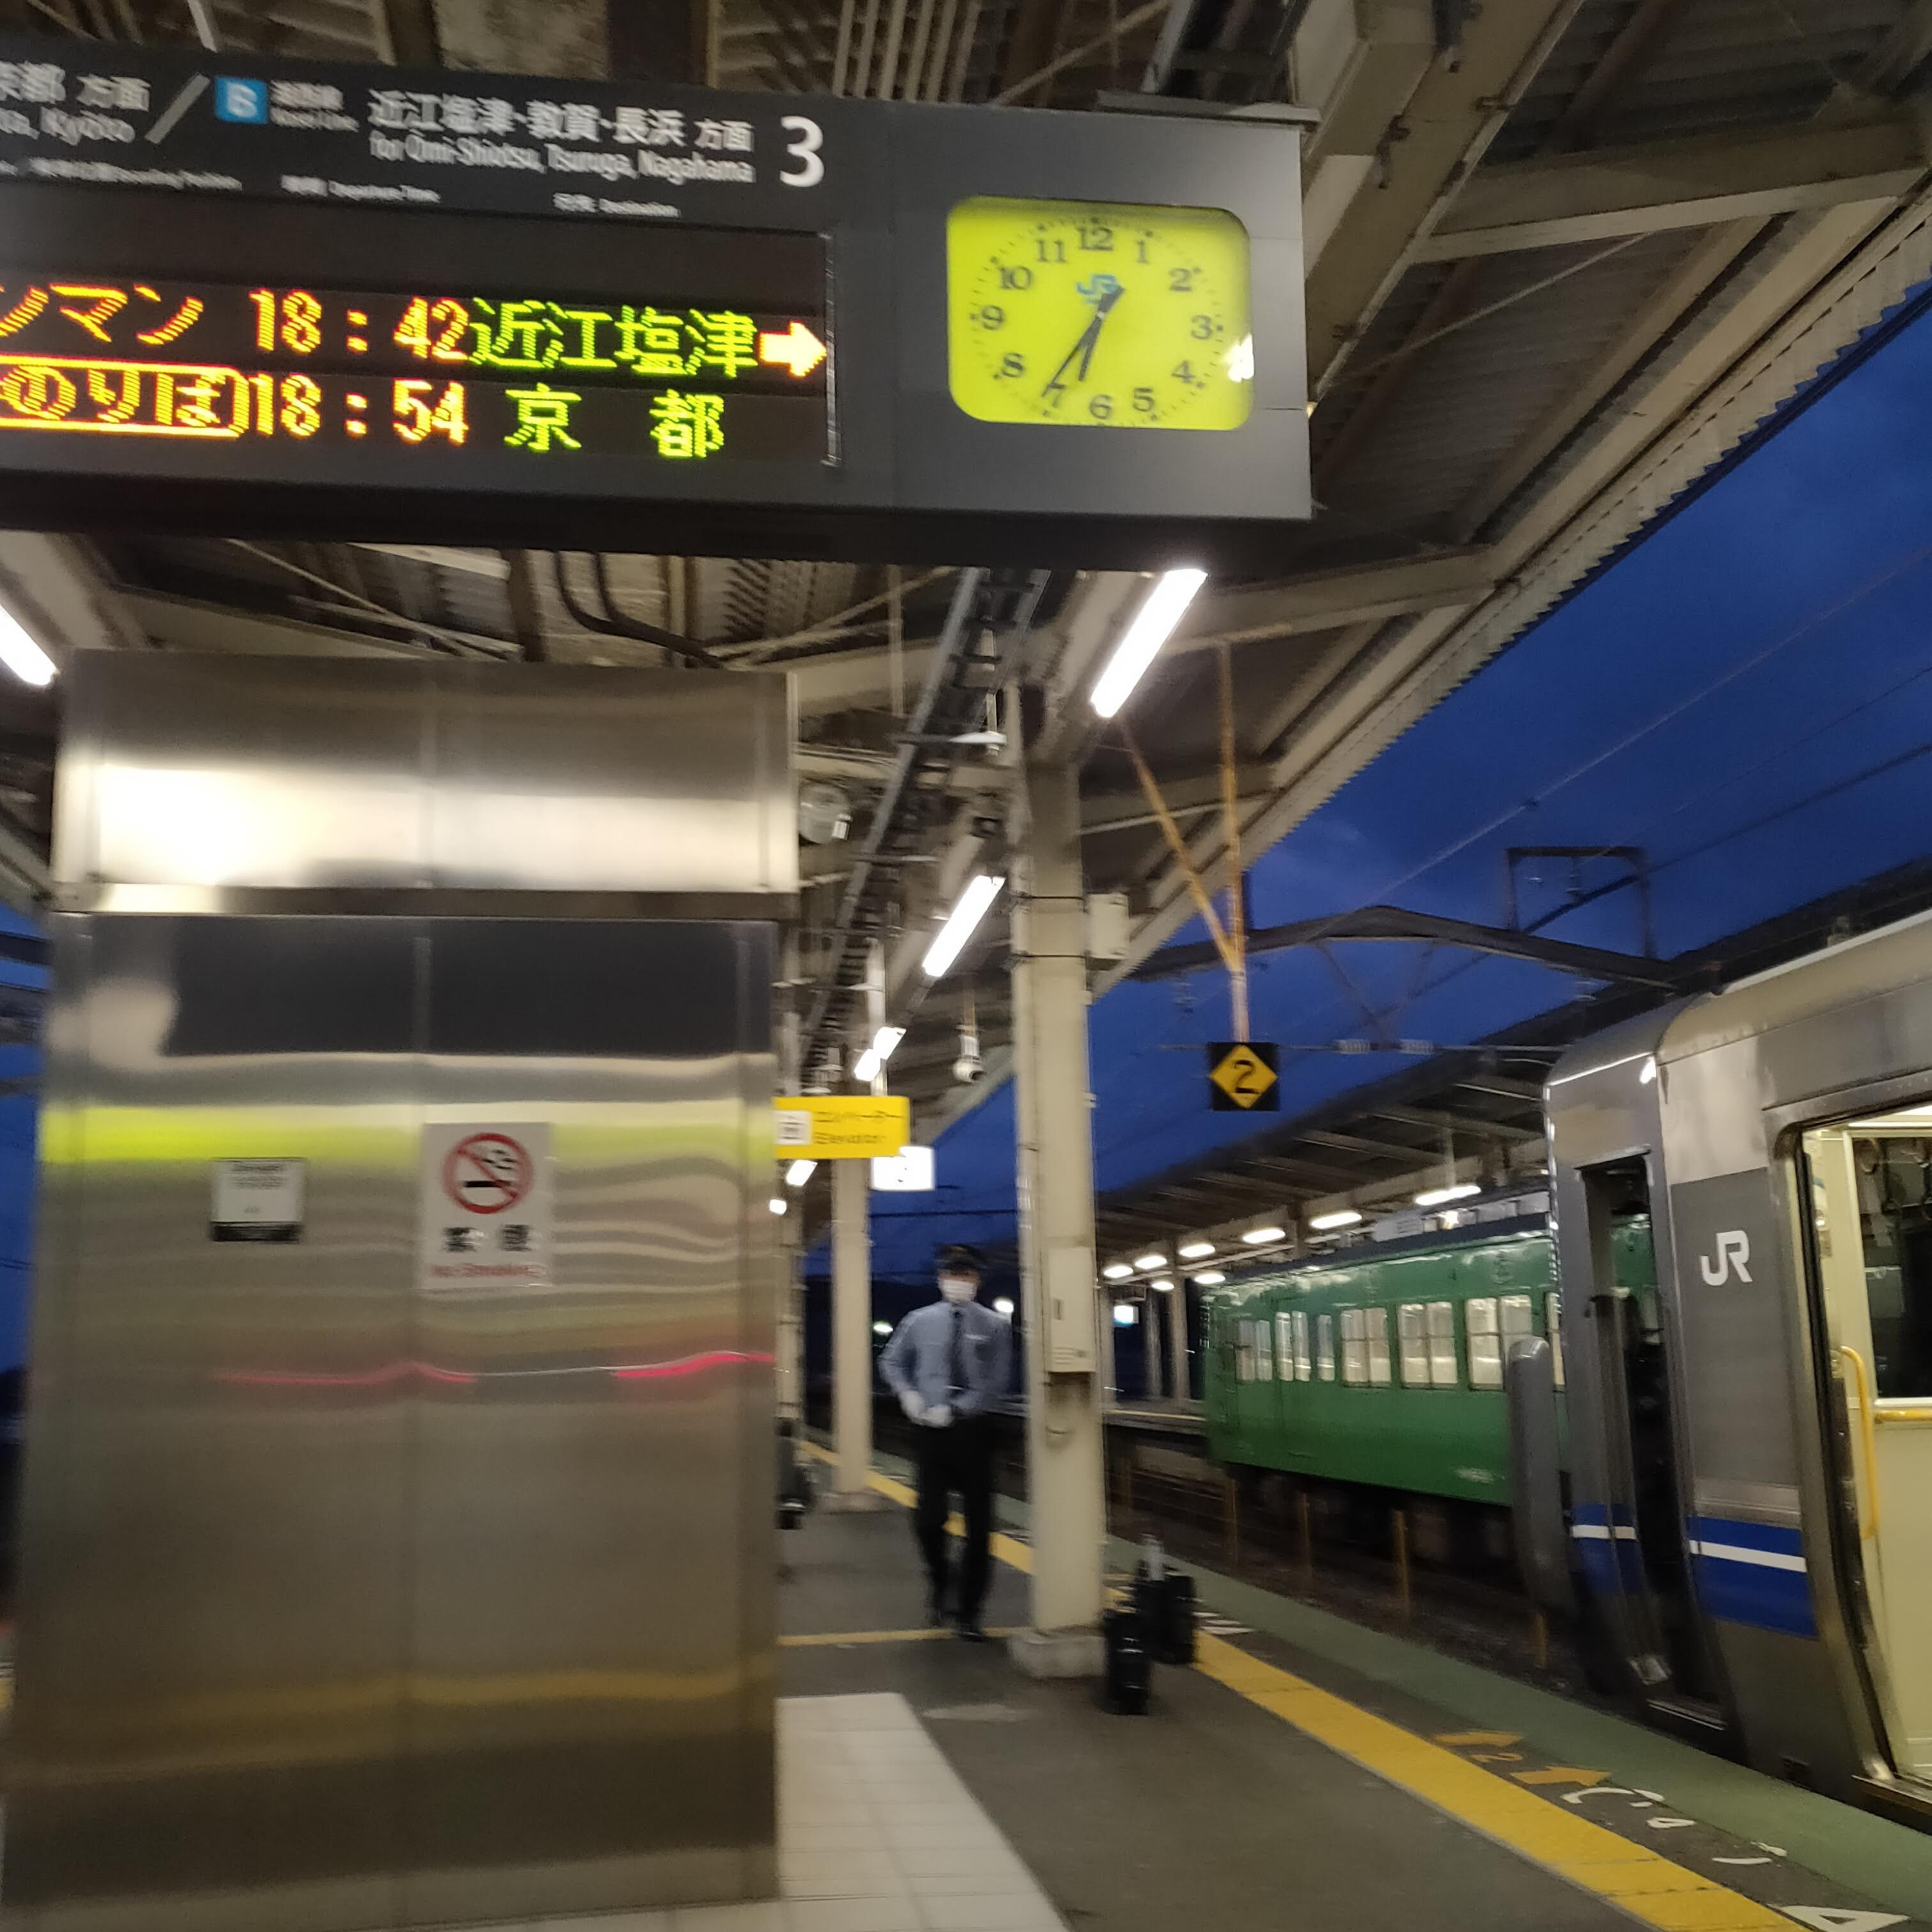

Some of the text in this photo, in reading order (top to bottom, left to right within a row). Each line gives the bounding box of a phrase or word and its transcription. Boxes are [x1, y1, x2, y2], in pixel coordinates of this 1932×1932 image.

[694, 117, 755, 152] 方面
[779, 116, 825, 188] 3
[638, 149, 756, 185] Nagahama
[1036, 239, 1068, 263] 11
[1077, 226, 1114, 251] 12
[1135, 240, 1150, 264] 1
[998, 266, 1032, 290] 10
[1169, 268, 1193, 292] 2
[981, 305, 1006, 330] 9
[1191, 316, 1213, 340] 3
[469, 297, 757, 378] 近江塩津
[1002, 352, 1025, 379] 8
[1171, 360, 1196, 384] 4
[1046, 384, 1066, 408] 7
[1088, 393, 1114, 420] 6
[1132, 388, 1155, 413] 5
[1234, 1059, 1259, 1094] 2
[1700, 1230, 1753, 1286] JR
